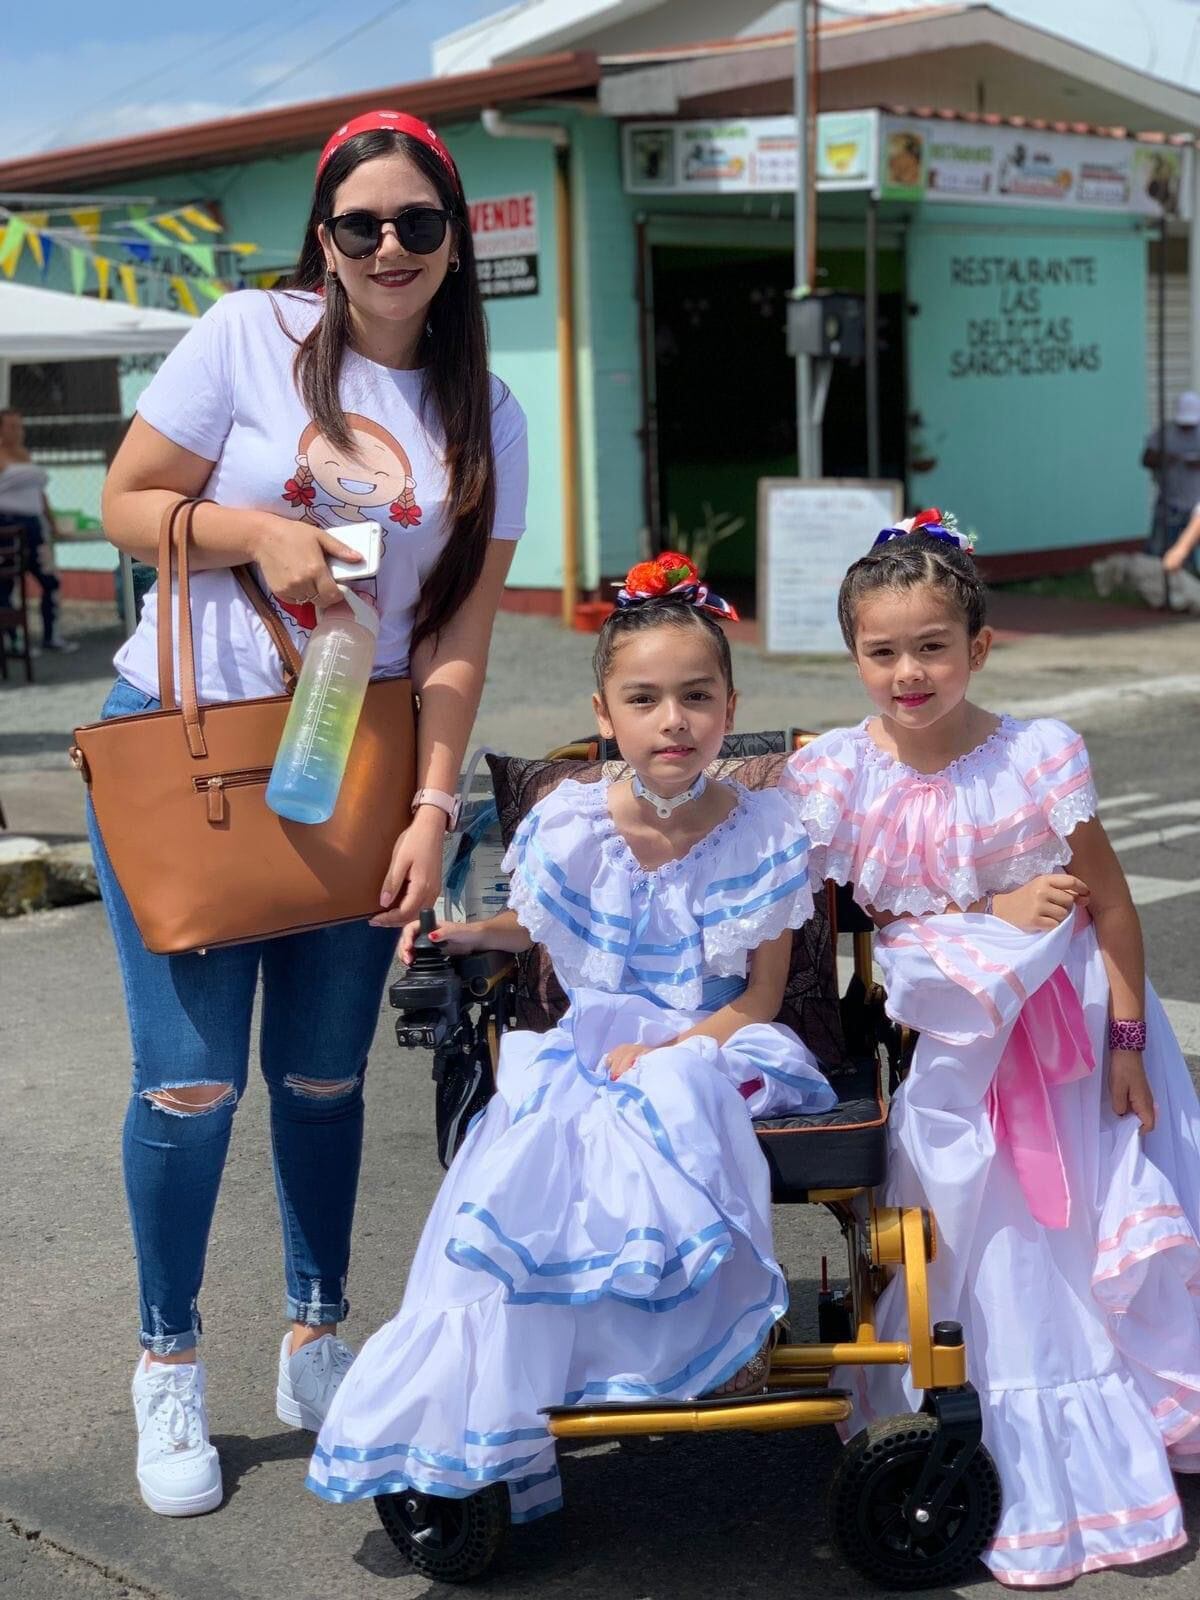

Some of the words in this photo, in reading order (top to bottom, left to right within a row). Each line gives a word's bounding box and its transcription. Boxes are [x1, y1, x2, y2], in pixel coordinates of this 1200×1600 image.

[468, 195, 534, 234] VENDE
[951, 256, 1096, 286] RESTAURANTE
[1001, 287, 1040, 315] LAS
